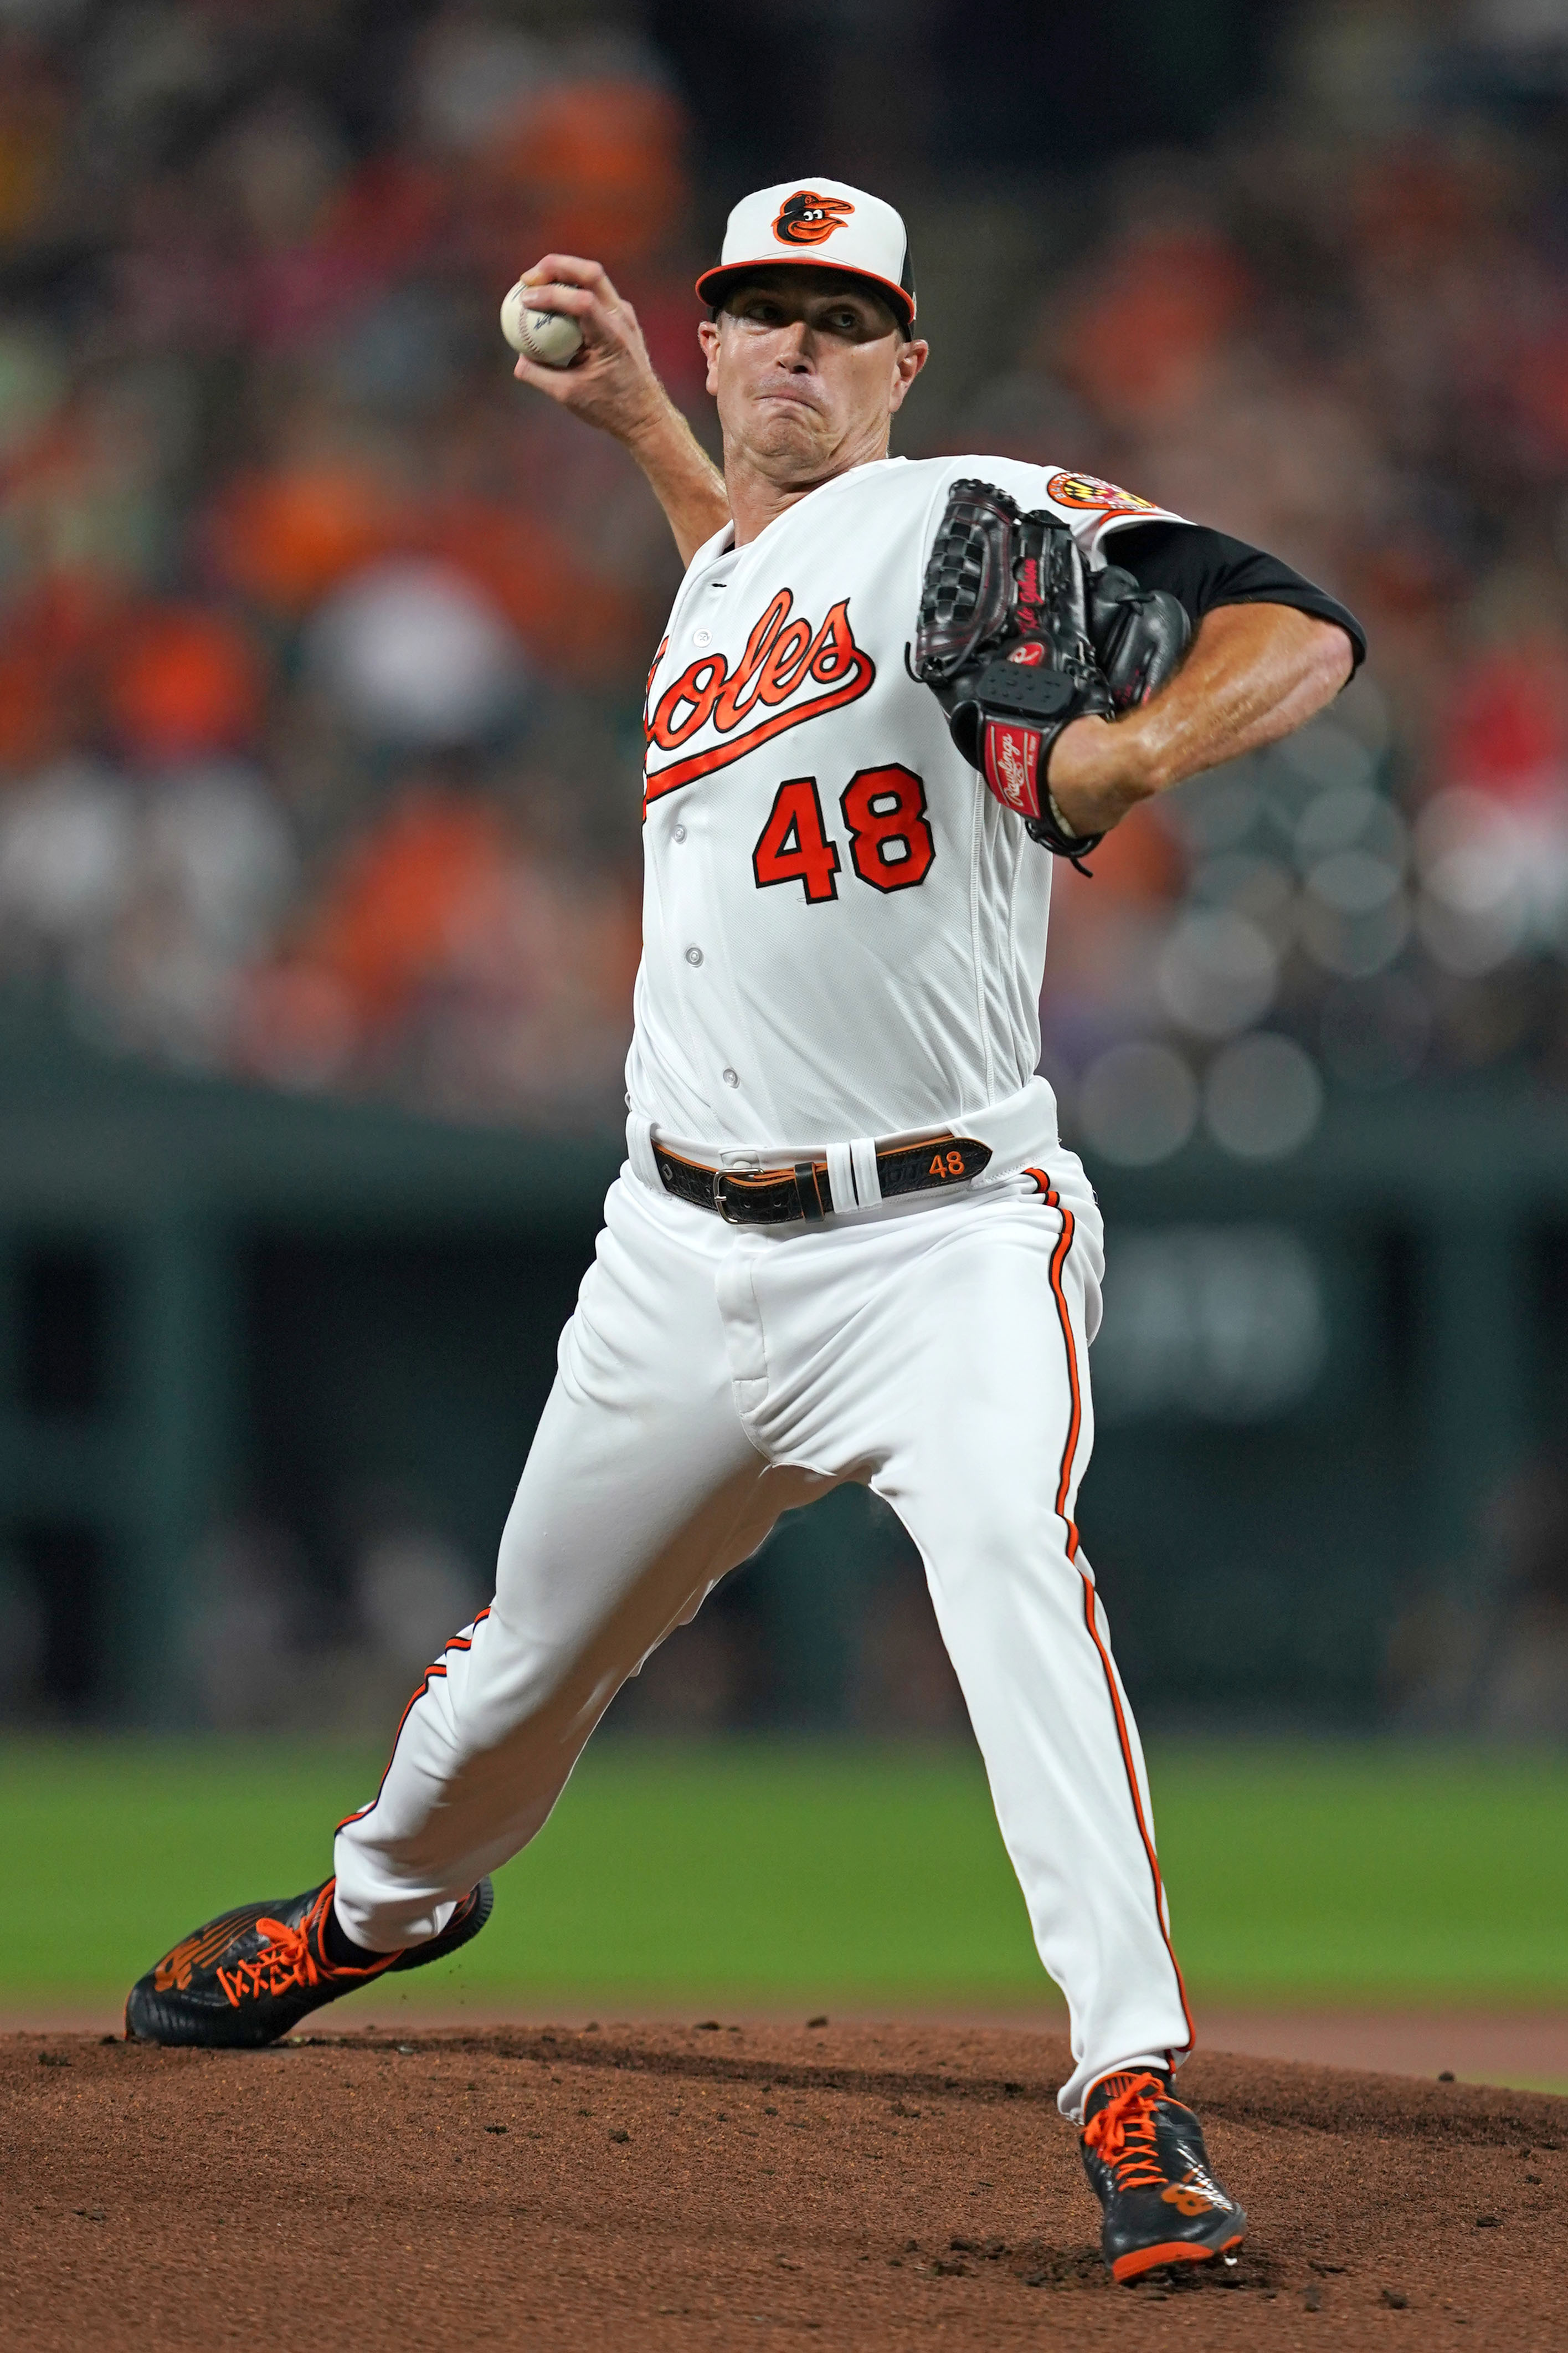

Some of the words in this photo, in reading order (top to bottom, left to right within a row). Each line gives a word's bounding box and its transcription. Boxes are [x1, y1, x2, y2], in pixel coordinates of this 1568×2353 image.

[644, 587, 876, 751] oles
[998, 732, 1024, 807] Rawlings
[752, 762, 936, 905] 48
[929, 1151, 965, 1178] 48
